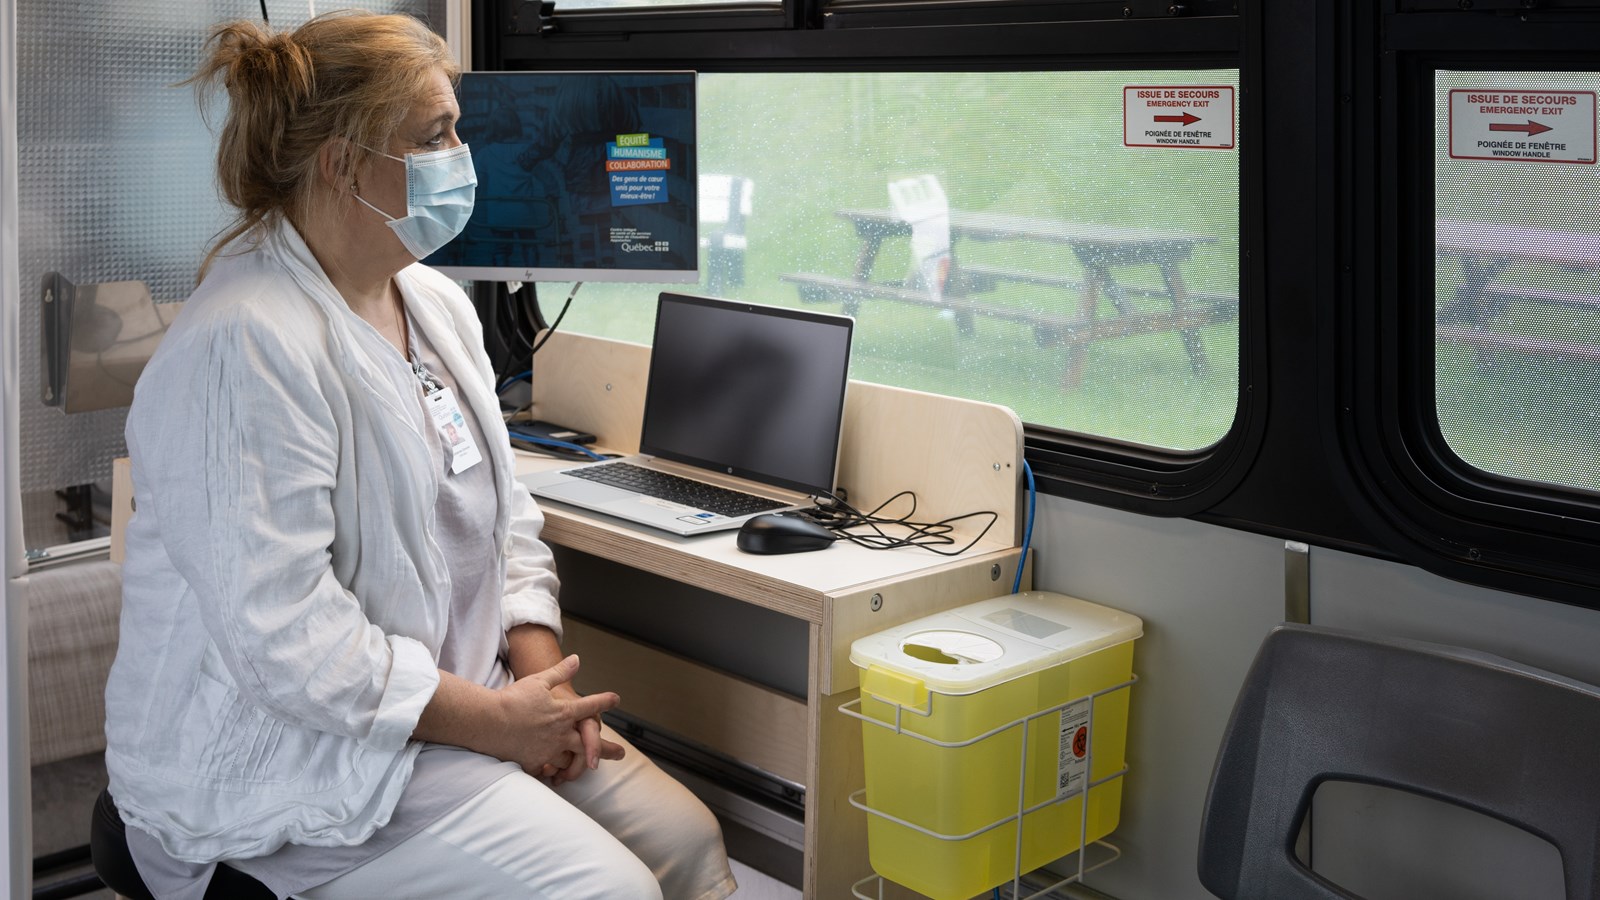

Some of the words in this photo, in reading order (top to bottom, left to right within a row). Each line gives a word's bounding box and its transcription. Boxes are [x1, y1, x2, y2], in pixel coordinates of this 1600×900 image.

[1137, 90, 1161, 98] ISSUE
[1164, 90, 1176, 98] DE
[1178, 90, 1220, 98] SECOURS
[1467, 94, 1500, 104] ISSUE
[1503, 95, 1519, 104] DE
[1522, 96, 1576, 105] SECOURS
[1480, 106, 1539, 114] EMERGENCY
[1542, 107, 1564, 115] EXIT
[620, 135, 646, 146] ÉQUITÉ
[1478, 140, 1513, 149] POIGNÉE
[1528, 142, 1566, 150] FENÊTRE
[614, 148, 662, 159] HUMANISME
[609, 160, 668, 170] COLLABORATION
[621, 242, 654, 252] Québec
